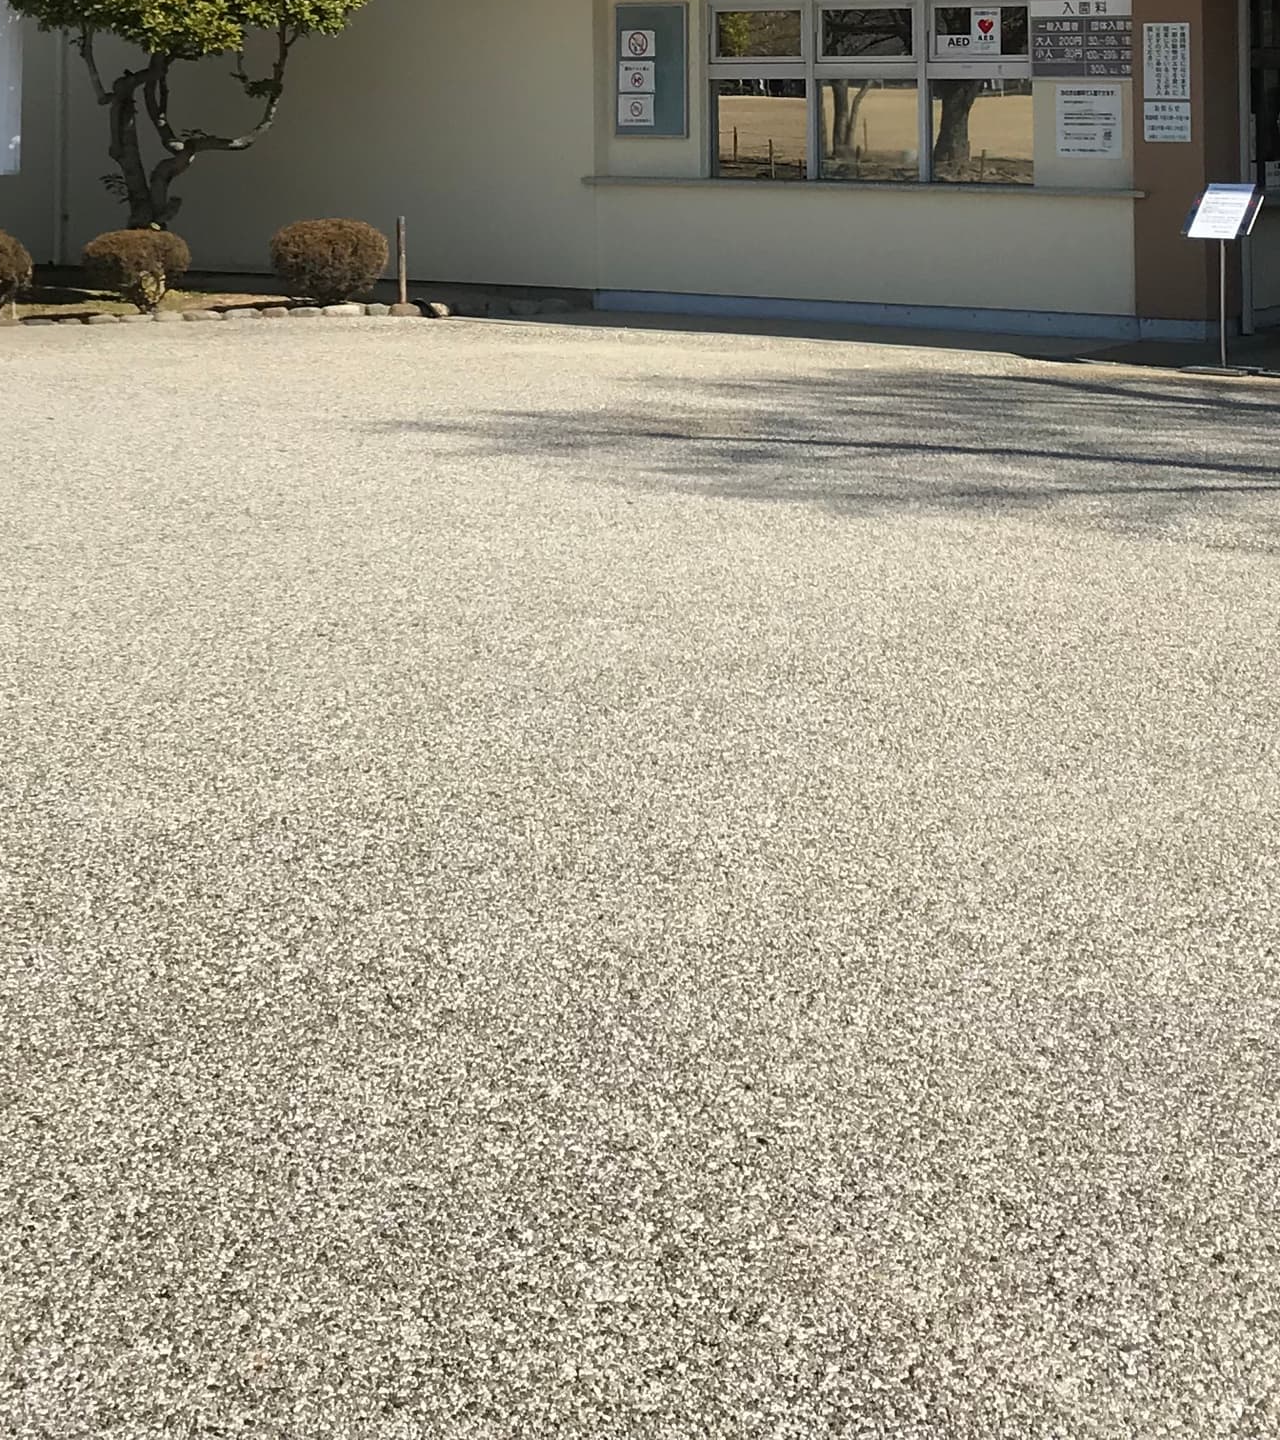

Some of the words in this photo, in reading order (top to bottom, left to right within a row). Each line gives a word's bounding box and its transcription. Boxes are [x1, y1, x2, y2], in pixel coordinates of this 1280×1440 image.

[1062, 1, 1107, 15] 入園料
[947, 37, 970, 47] AED
[1035, 36, 1053, 46] 大人
